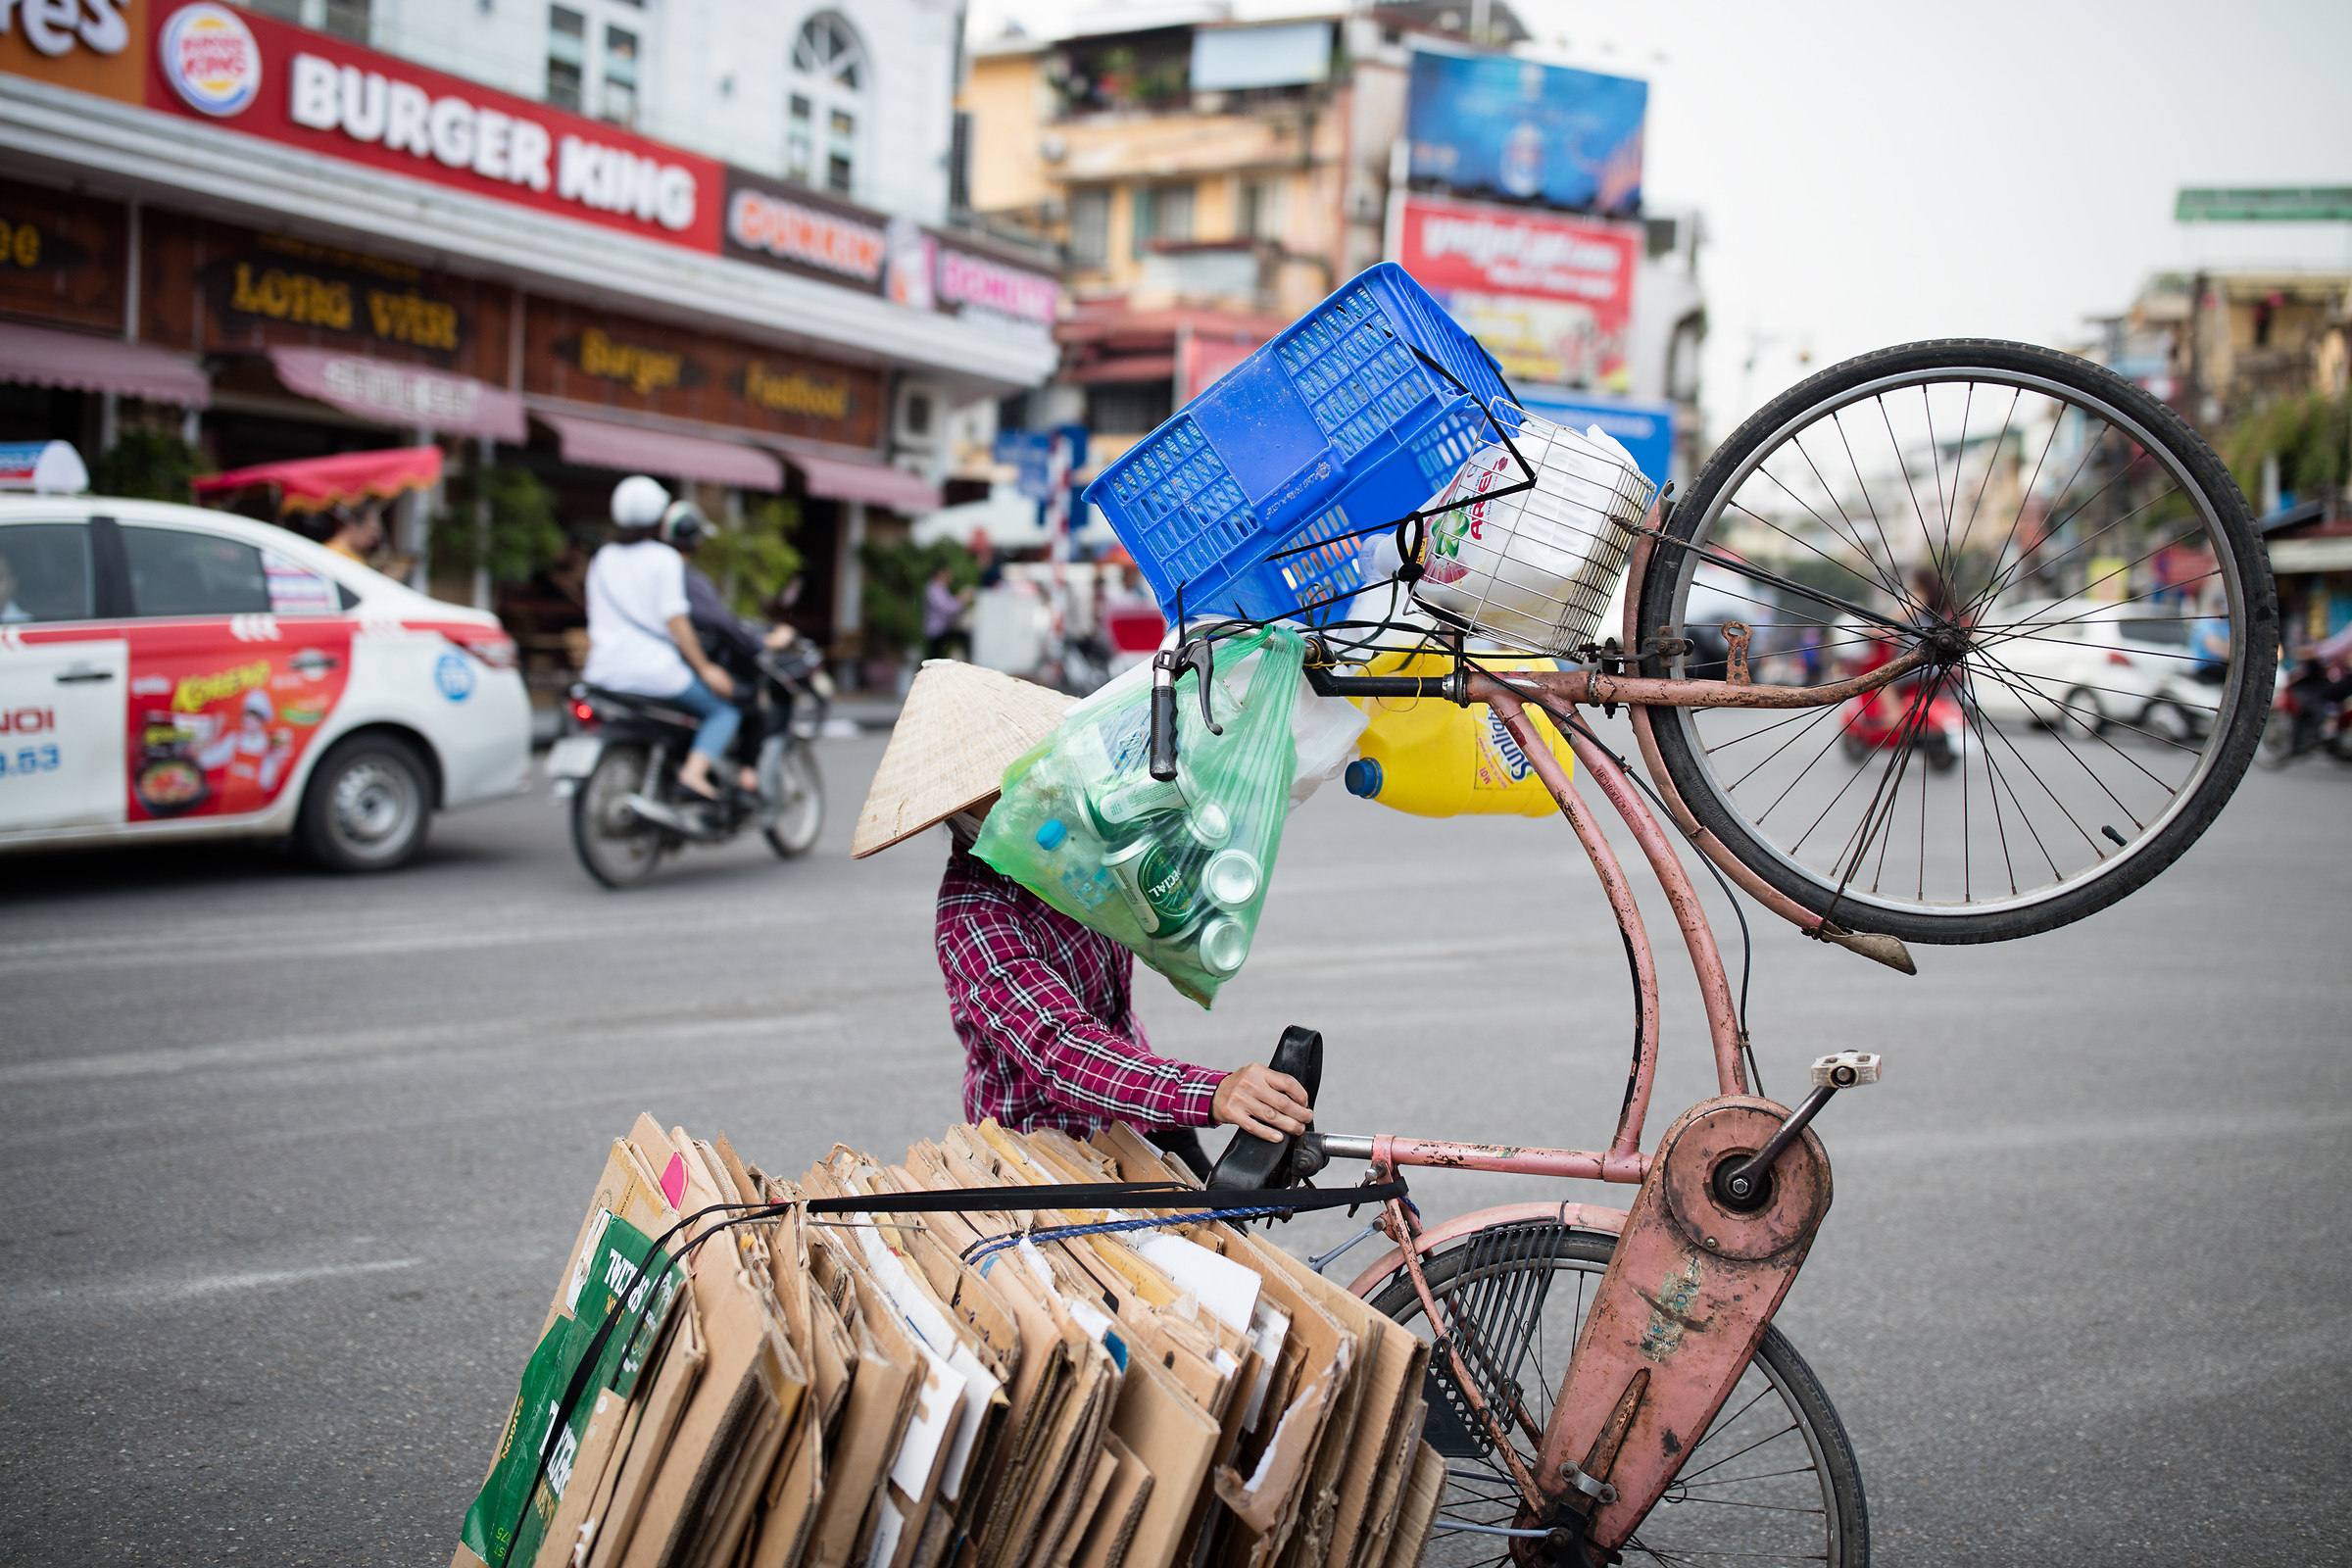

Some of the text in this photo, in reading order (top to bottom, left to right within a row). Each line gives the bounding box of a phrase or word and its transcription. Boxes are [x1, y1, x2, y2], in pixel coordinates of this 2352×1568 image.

[291, 53, 697, 231] BURGER KING
[231, 262, 353, 331] LONG
[581, 325, 681, 396] Burger
[1470, 461, 1499, 540] AREL
[0, 743, 62, 778] .53
[604, 1248, 651, 1314] SPCIAL
[499, 1395, 525, 1461] SAIGON
